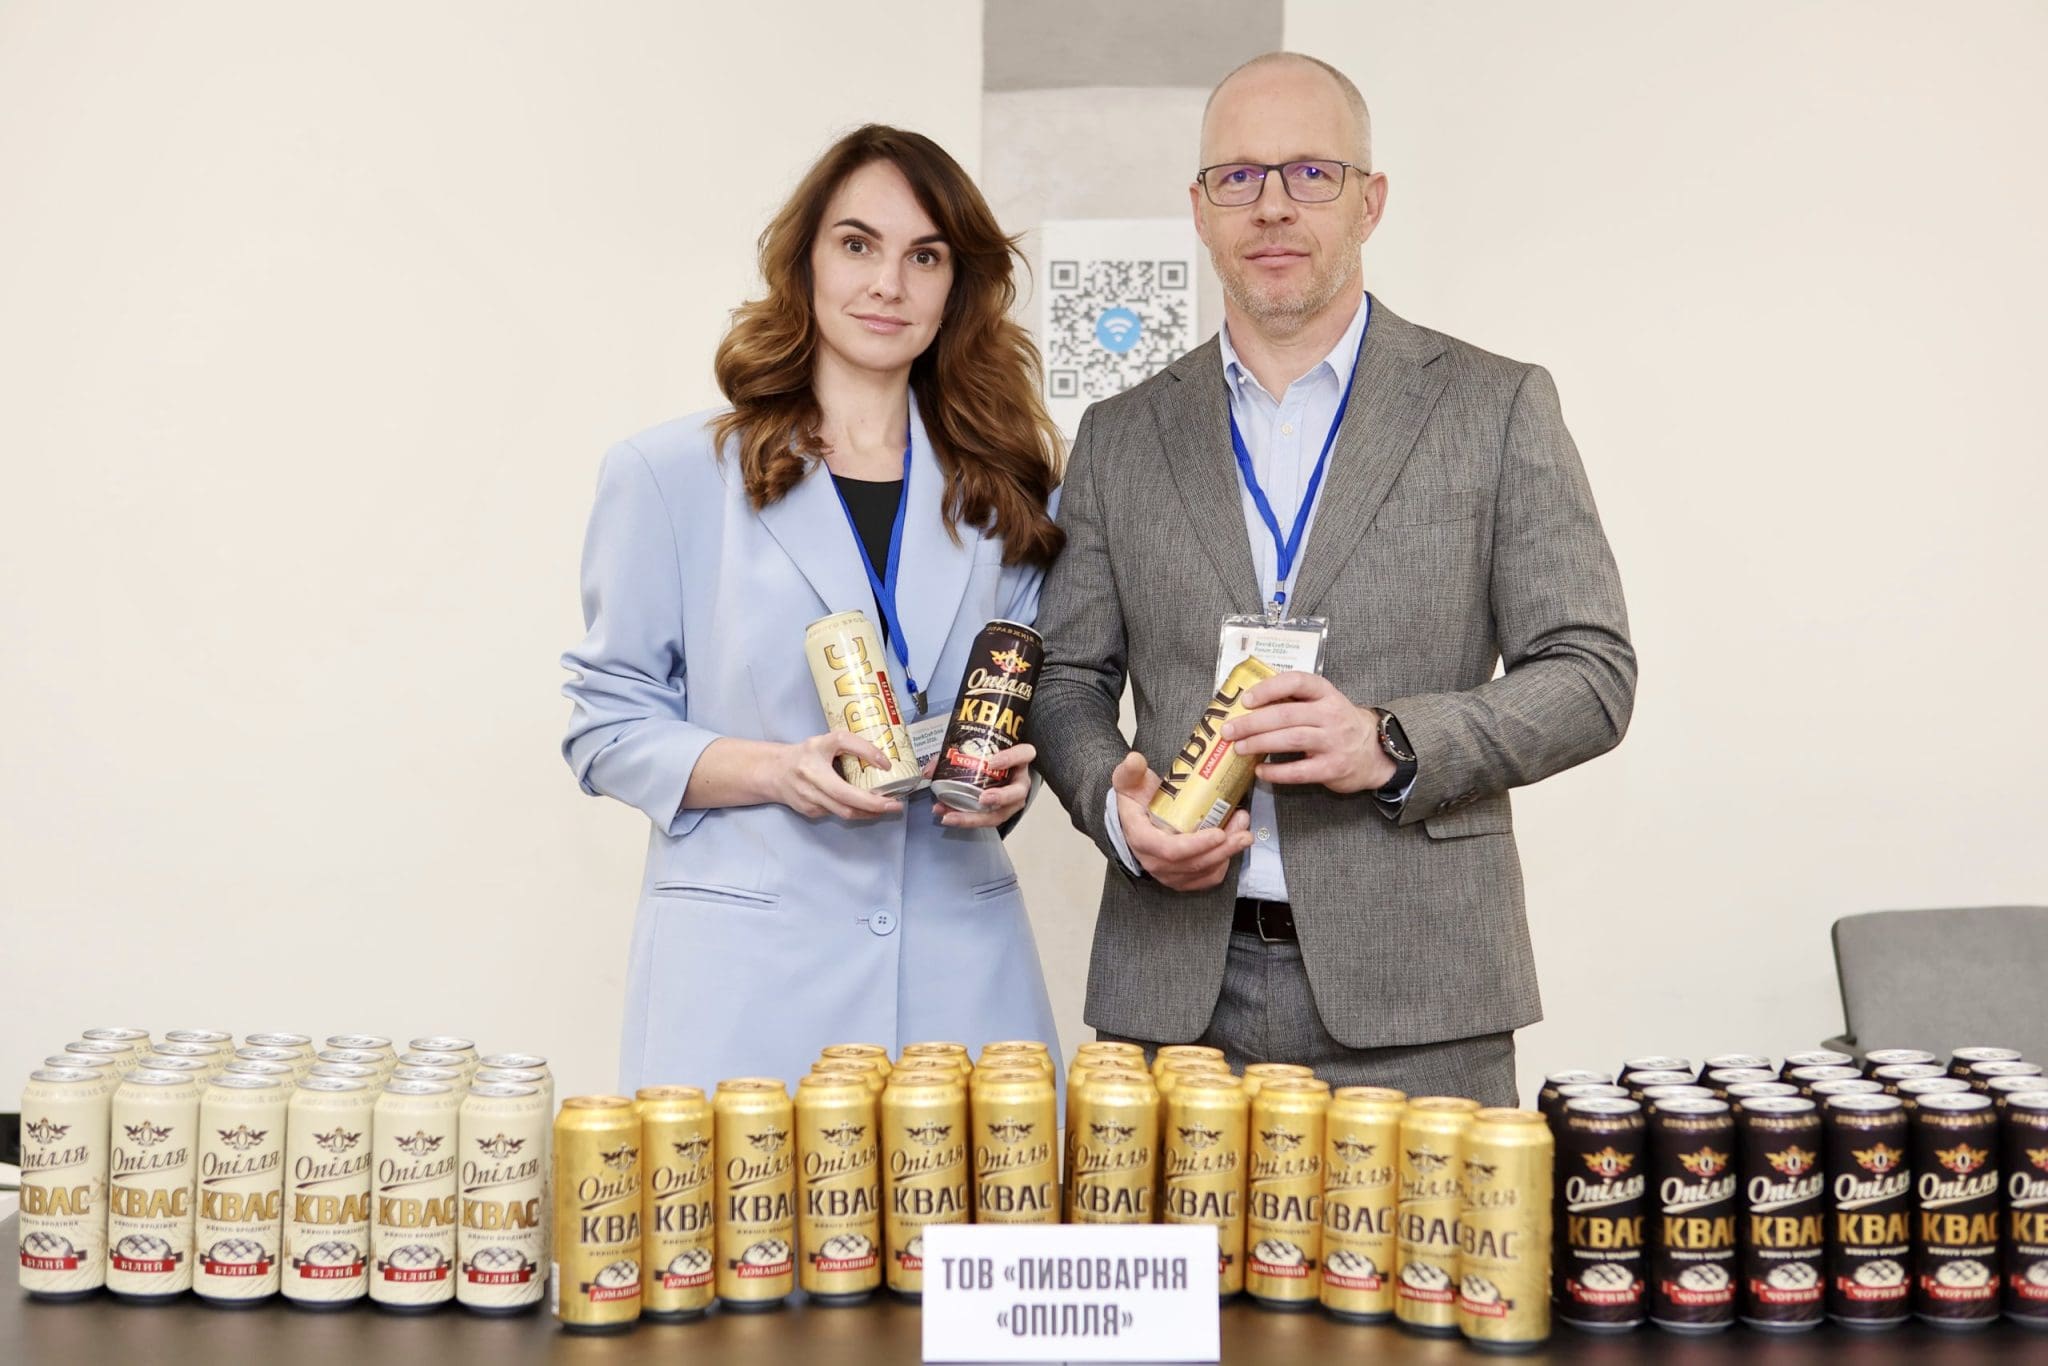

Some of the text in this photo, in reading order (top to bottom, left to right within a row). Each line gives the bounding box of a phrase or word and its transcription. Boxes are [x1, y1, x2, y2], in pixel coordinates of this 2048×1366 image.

[968, 667, 1033, 697] Опілля
[959, 697, 1024, 741] КВАС
[112, 1147, 188, 1171] Опілля
[201, 1150, 280, 1176] Опілля
[294, 1152, 372, 1180] Опілля
[378, 1156, 455, 1182] Опілля
[462, 1159, 540, 1185] Опілля
[1328, 1162, 1394, 1185] пілля
[20, 1184, 91, 1216] КВАС
[110, 1184, 188, 1219] КВАС
[200, 1188, 280, 1222] КВАС
[294, 1191, 370, 1225] КВАС
[378, 1195, 455, 1228] КВАС
[892, 1184, 967, 1216] КВАС
[978, 1182, 1052, 1212] КВАС
[1075, 1181, 1149, 1214] КВАС
[462, 1197, 540, 1230] КВАС
[581, 1211, 639, 1243] КВА
[655, 1200, 714, 1232] КВА
[2011, 1212, 2048, 1245] КВ
[1462, 1226, 1518, 1260] ВАС
[1568, 1215, 1645, 1249] КВАС
[941, 1257, 993, 1290] ТОВ
[1004, 1257, 1188, 1290] «ПИВОВАРНЯ
[997, 1304, 1133, 1337] «ОПІЛЛЯ»
